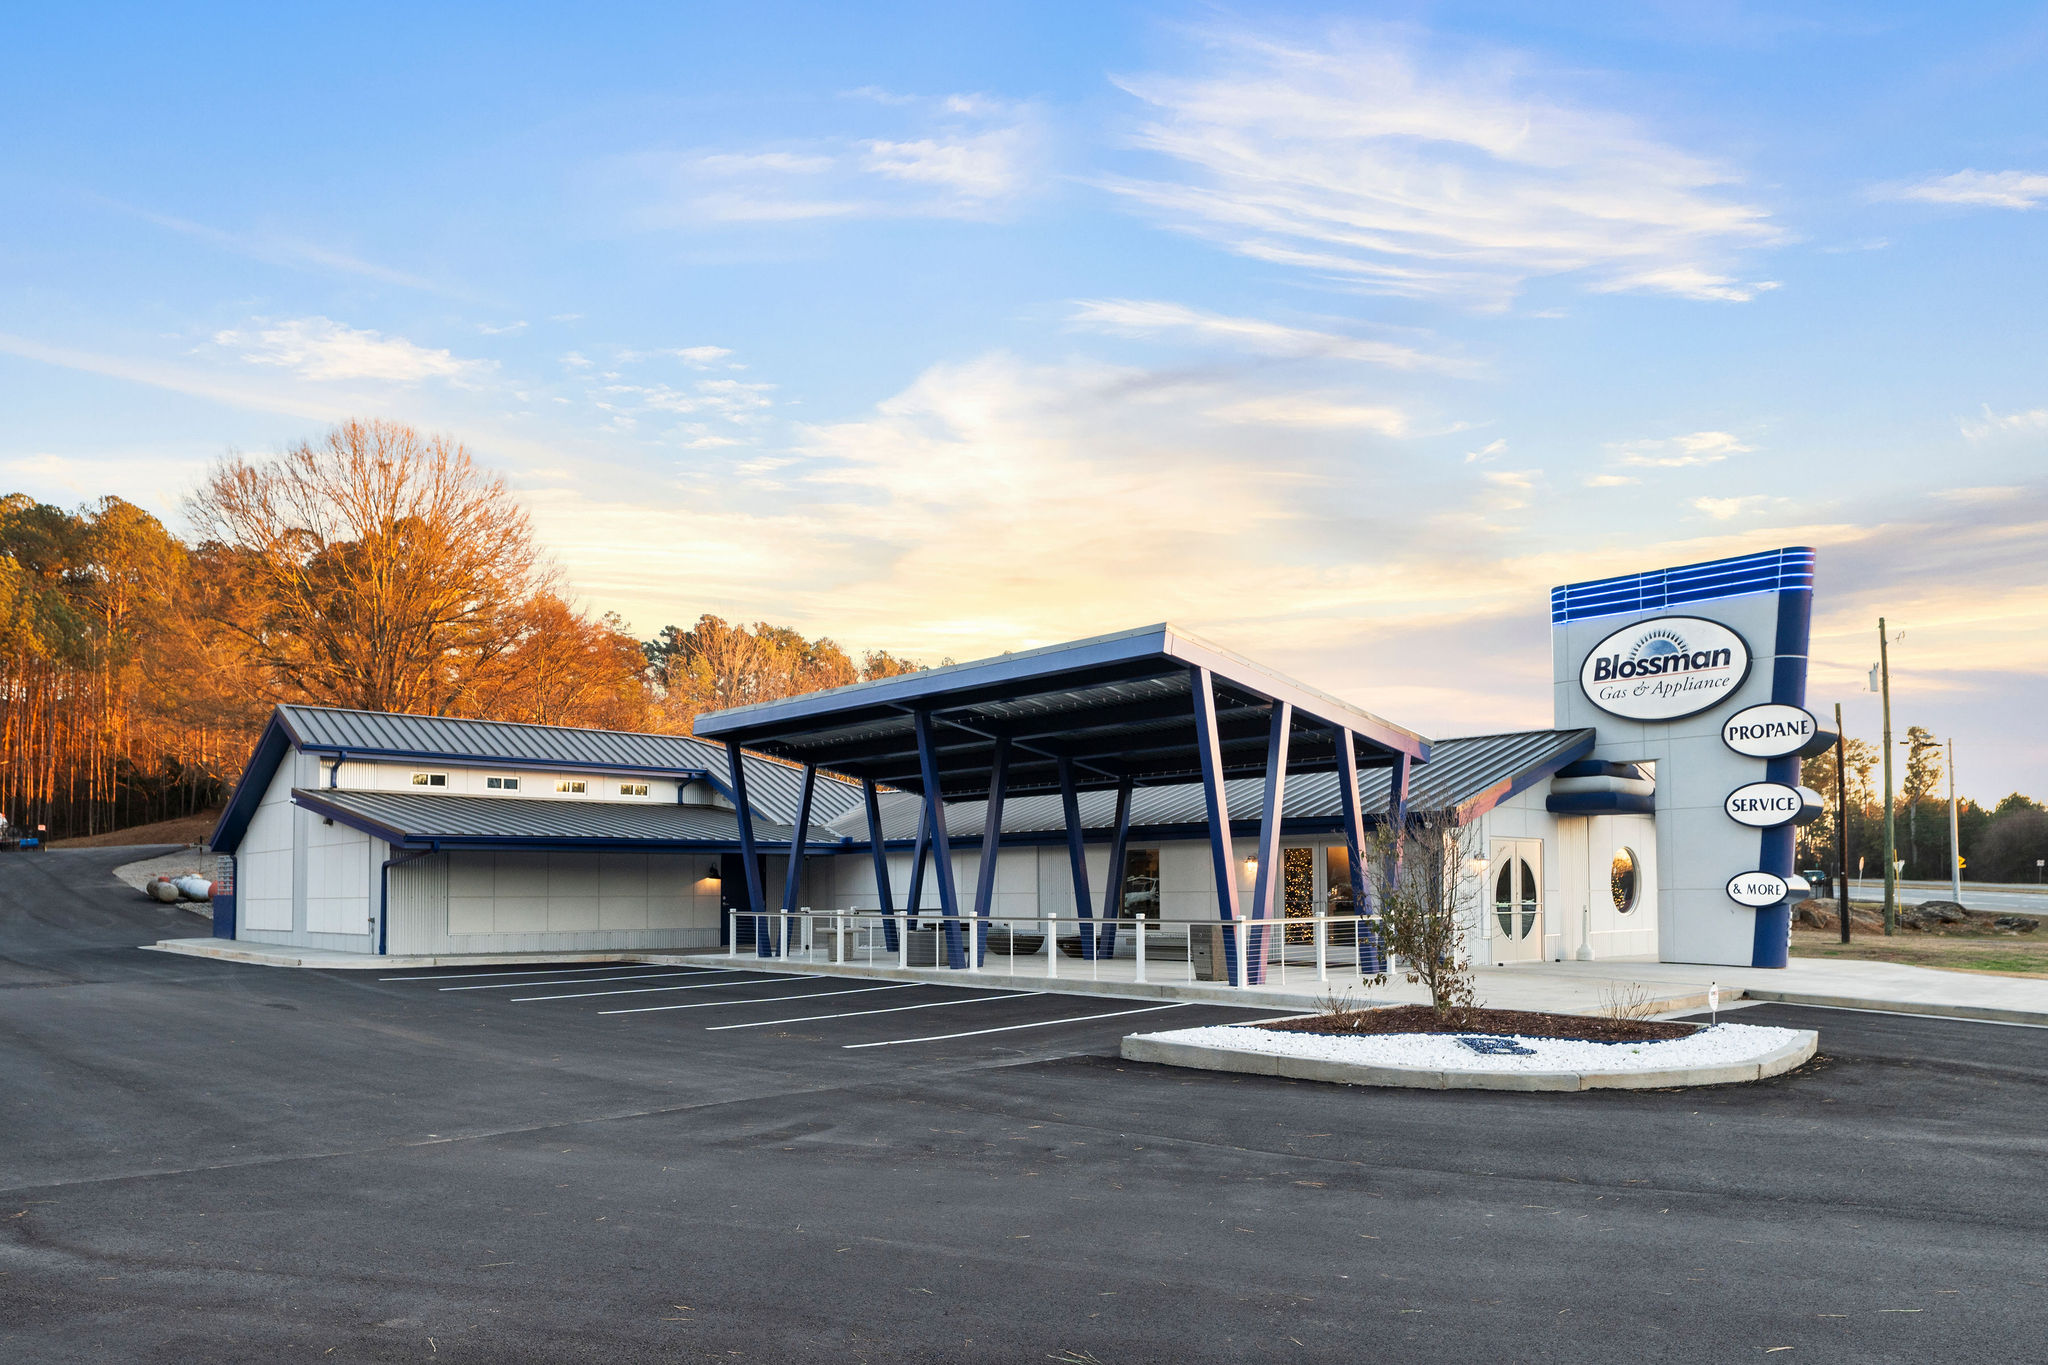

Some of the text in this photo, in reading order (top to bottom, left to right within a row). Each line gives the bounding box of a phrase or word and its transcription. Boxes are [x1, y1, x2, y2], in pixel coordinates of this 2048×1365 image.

[1593, 647, 1731, 682] Blossman
[1599, 676, 1731, 701] Gas & Appliance
[1728, 719, 1810, 741] PROPANE
[1731, 797, 1796, 812] SERVICE
[1732, 884, 1782, 896] & MORE
